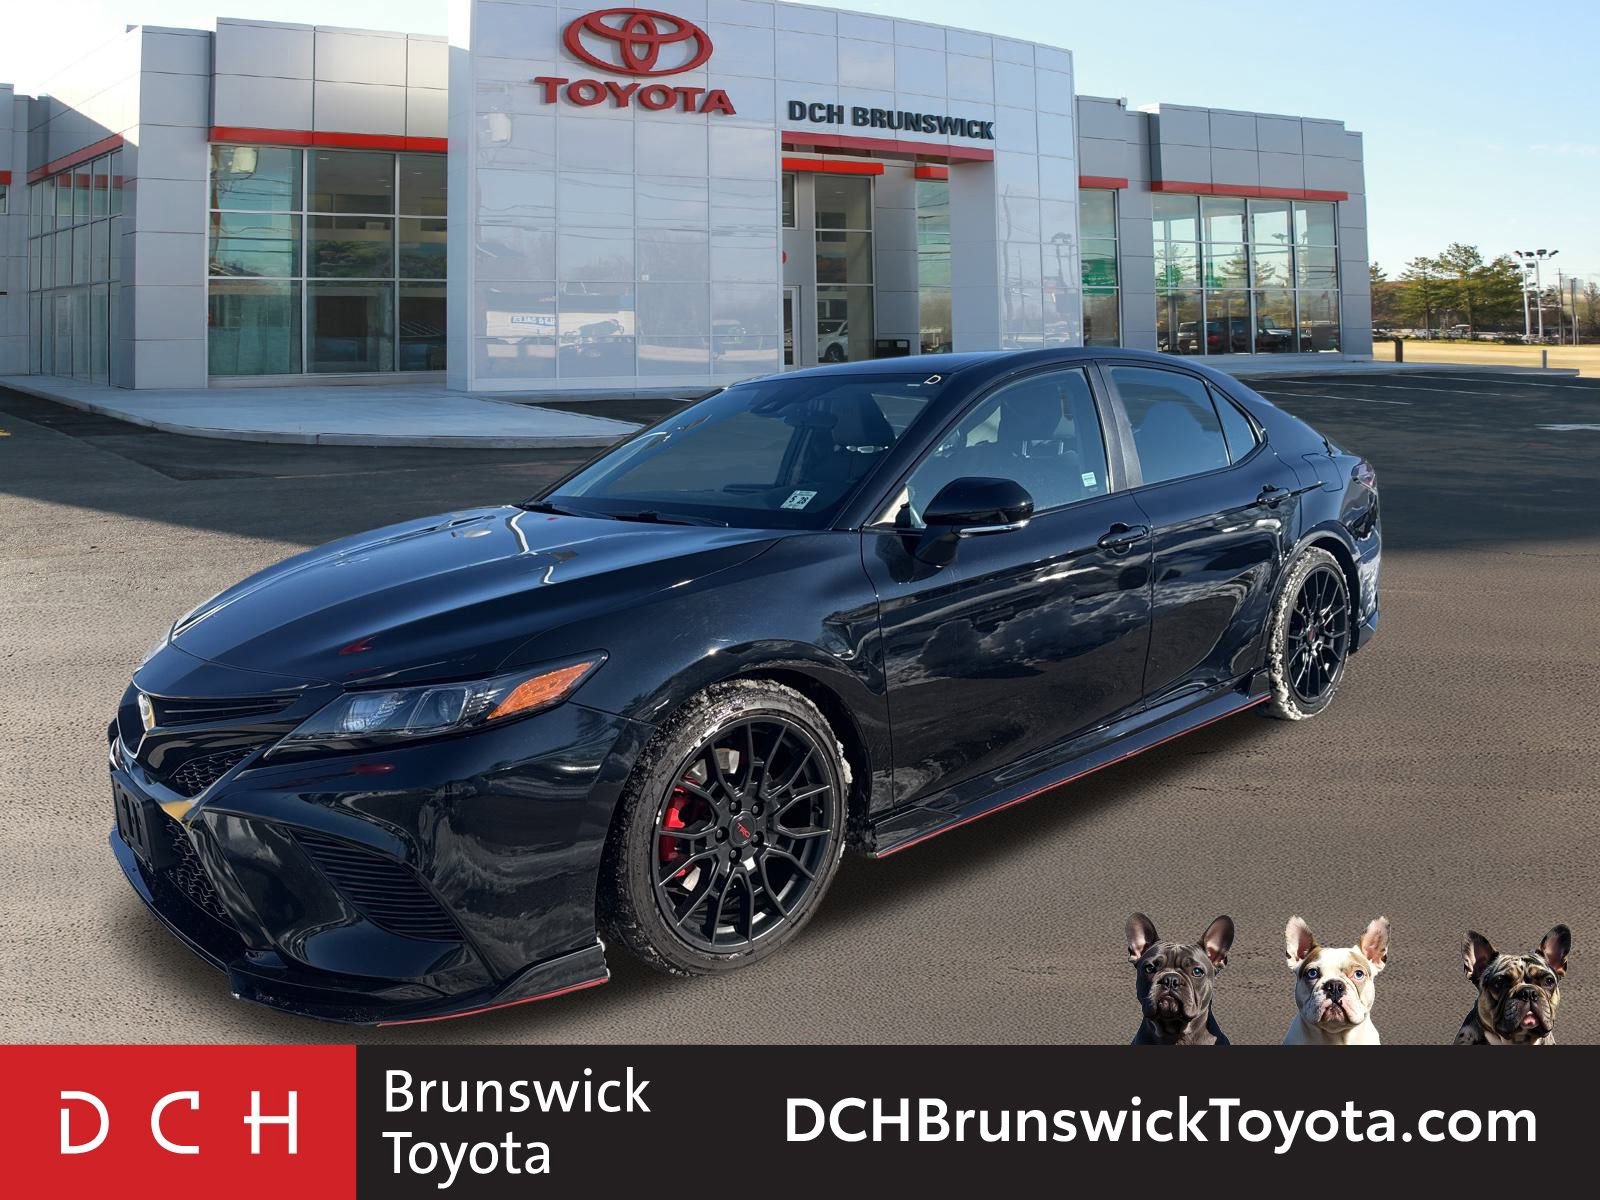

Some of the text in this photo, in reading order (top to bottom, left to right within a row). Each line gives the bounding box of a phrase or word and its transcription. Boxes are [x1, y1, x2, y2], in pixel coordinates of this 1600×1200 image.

[534, 76, 736, 115] TOYOTA
[788, 100, 995, 140] DCH BRUNSWICK
